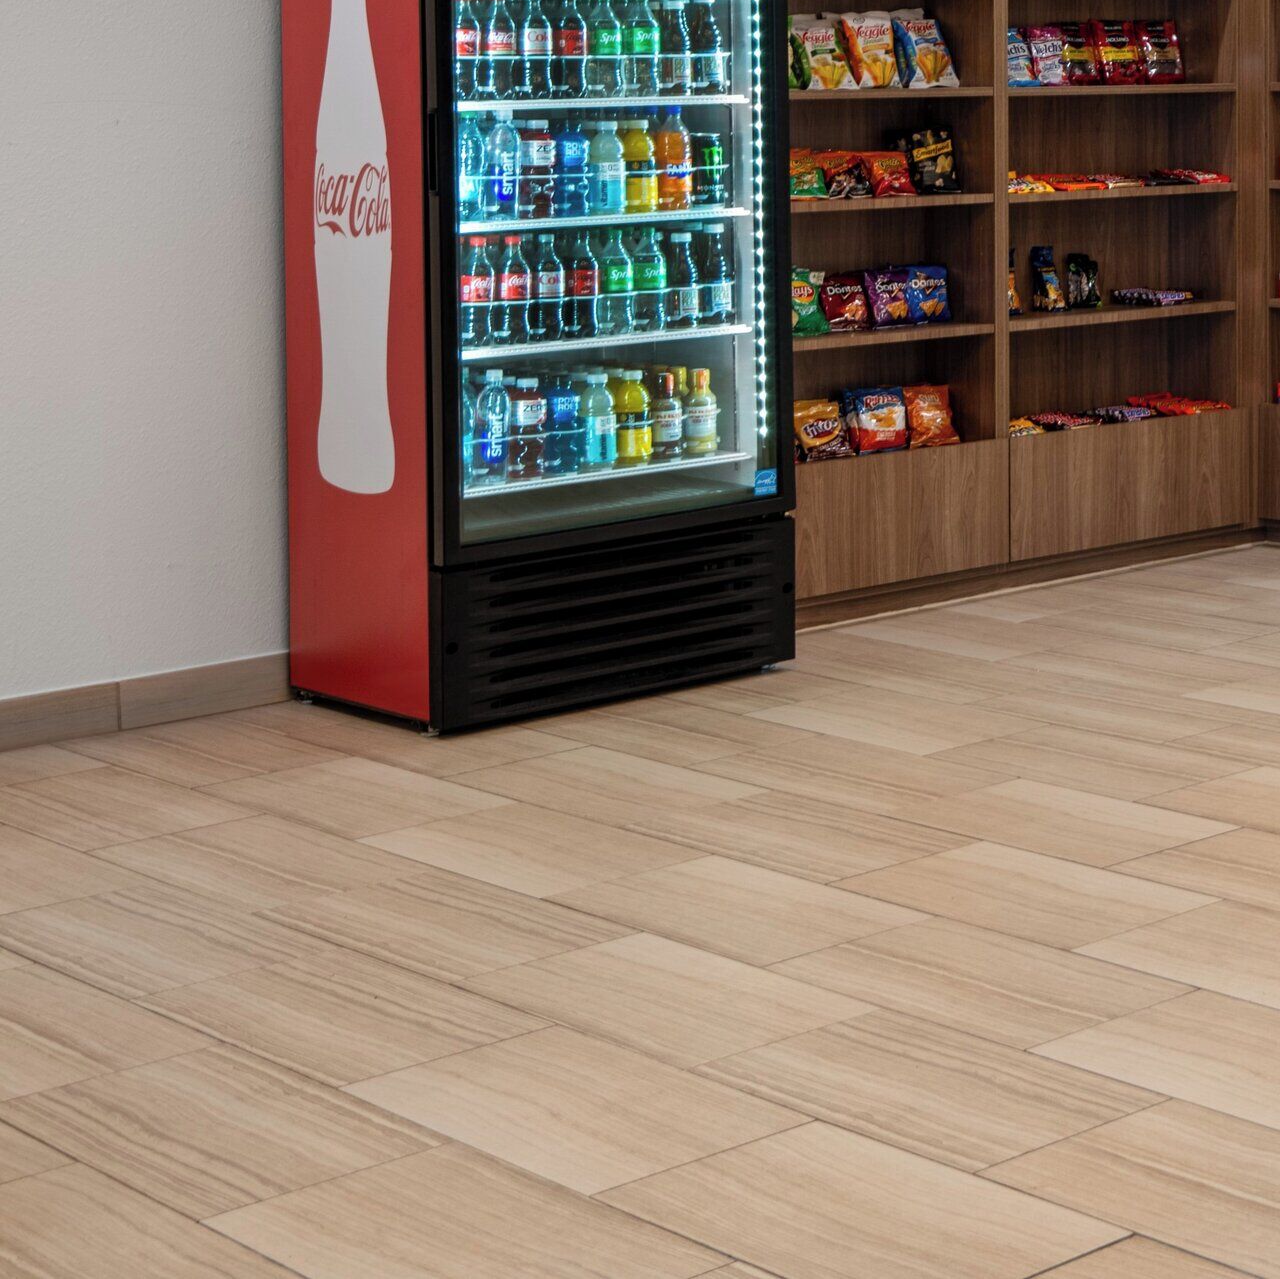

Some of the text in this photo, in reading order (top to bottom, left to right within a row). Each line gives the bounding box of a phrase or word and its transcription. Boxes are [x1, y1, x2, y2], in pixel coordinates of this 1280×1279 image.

[855, 25, 890, 39] Veggie
[904, 22, 935, 34] Veggie
[801, 31, 834, 45] Veggie
[316, 162, 391, 239] Coca-Cola
